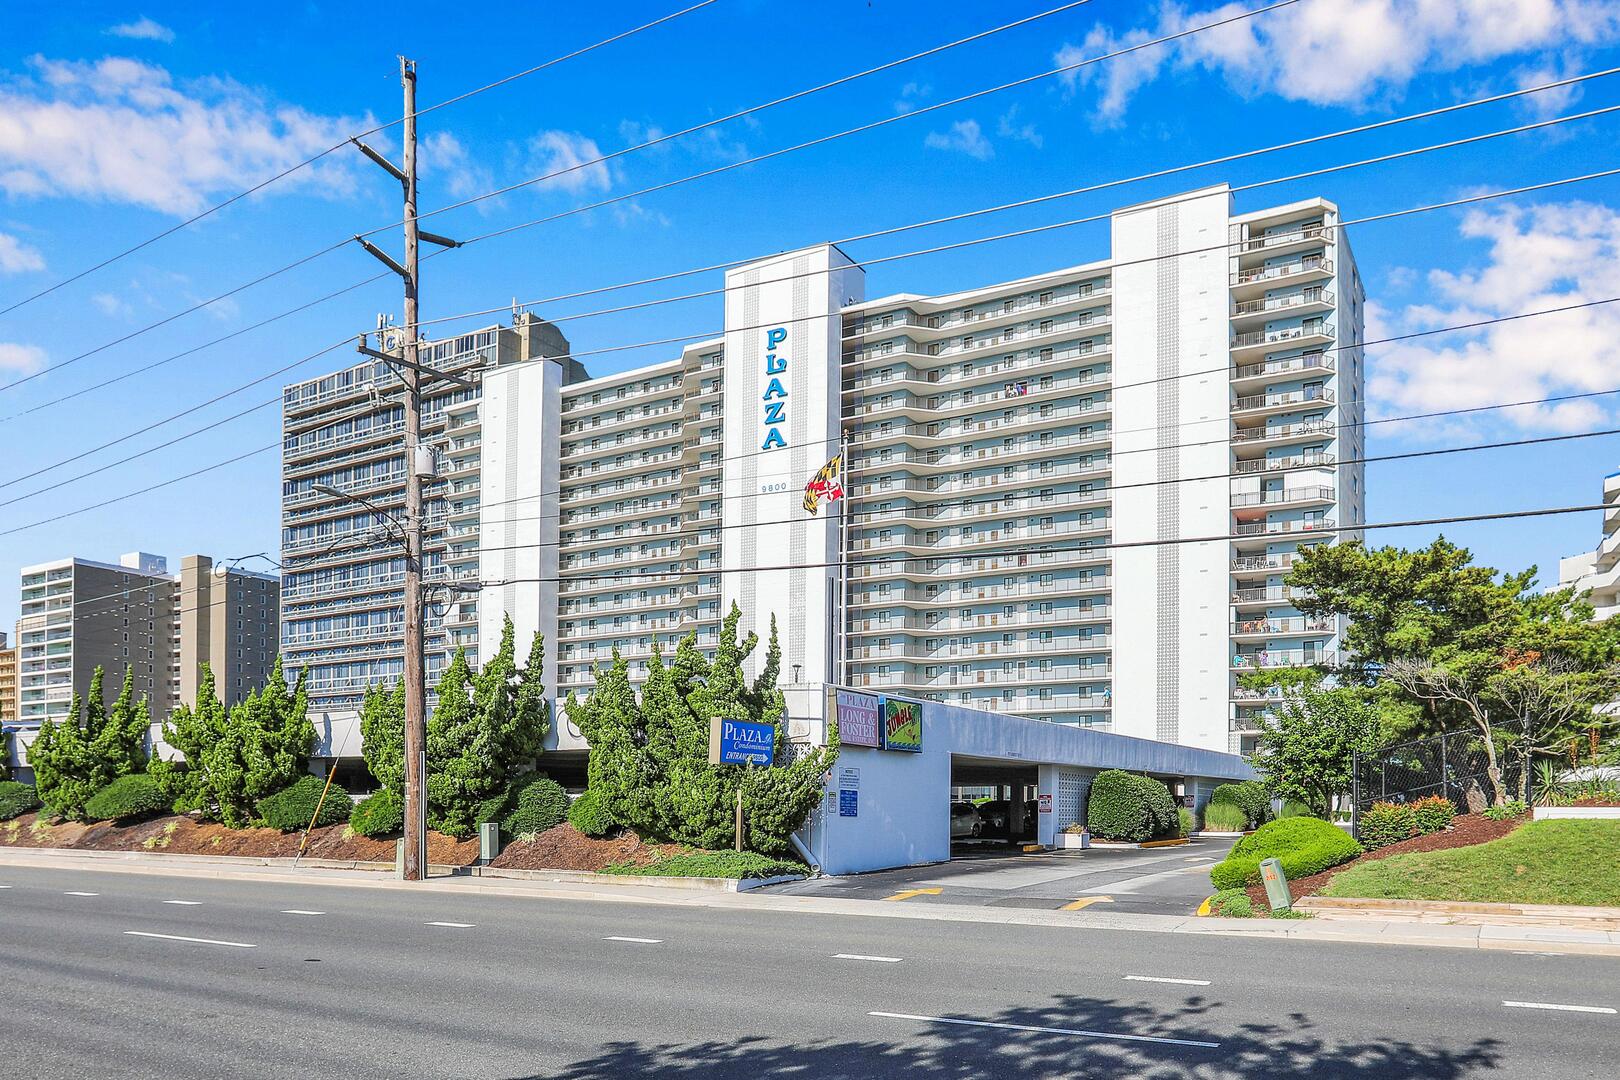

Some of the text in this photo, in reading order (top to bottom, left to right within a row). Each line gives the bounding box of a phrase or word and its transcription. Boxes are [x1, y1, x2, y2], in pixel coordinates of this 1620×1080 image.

[761, 327, 788, 449] PLAZA
[761, 482, 787, 493] 9800
[846, 694, 875, 709] PLAZA
[840, 708, 876, 726] LONG &
[886, 704, 913, 737] JUNGLE
[724, 722, 762, 743] PLAZA
[841, 721, 875, 738] FOSTER
